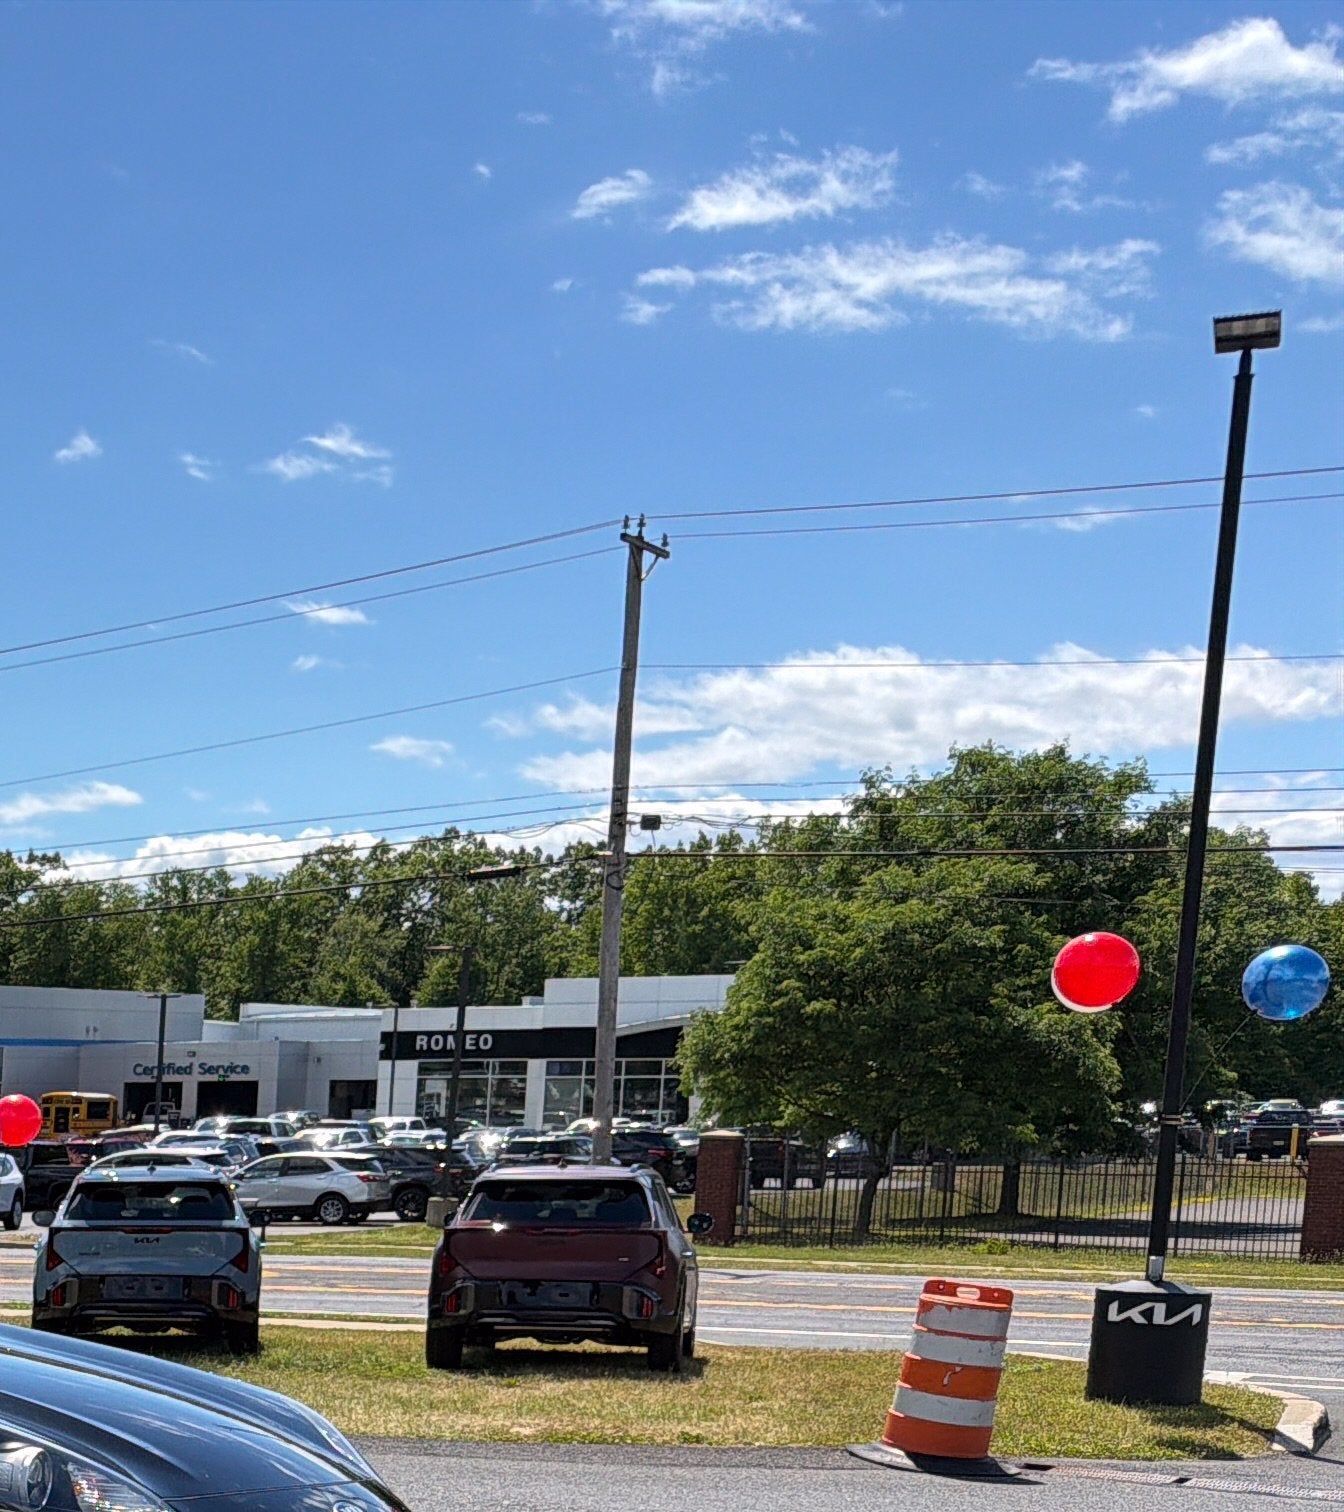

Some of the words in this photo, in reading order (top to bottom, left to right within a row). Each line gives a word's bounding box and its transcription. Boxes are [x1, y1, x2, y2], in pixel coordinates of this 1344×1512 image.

[133, 1062, 193, 1076] Cerified
[198, 1061, 250, 1076] Service
[1108, 1299, 1203, 1327] KIA
